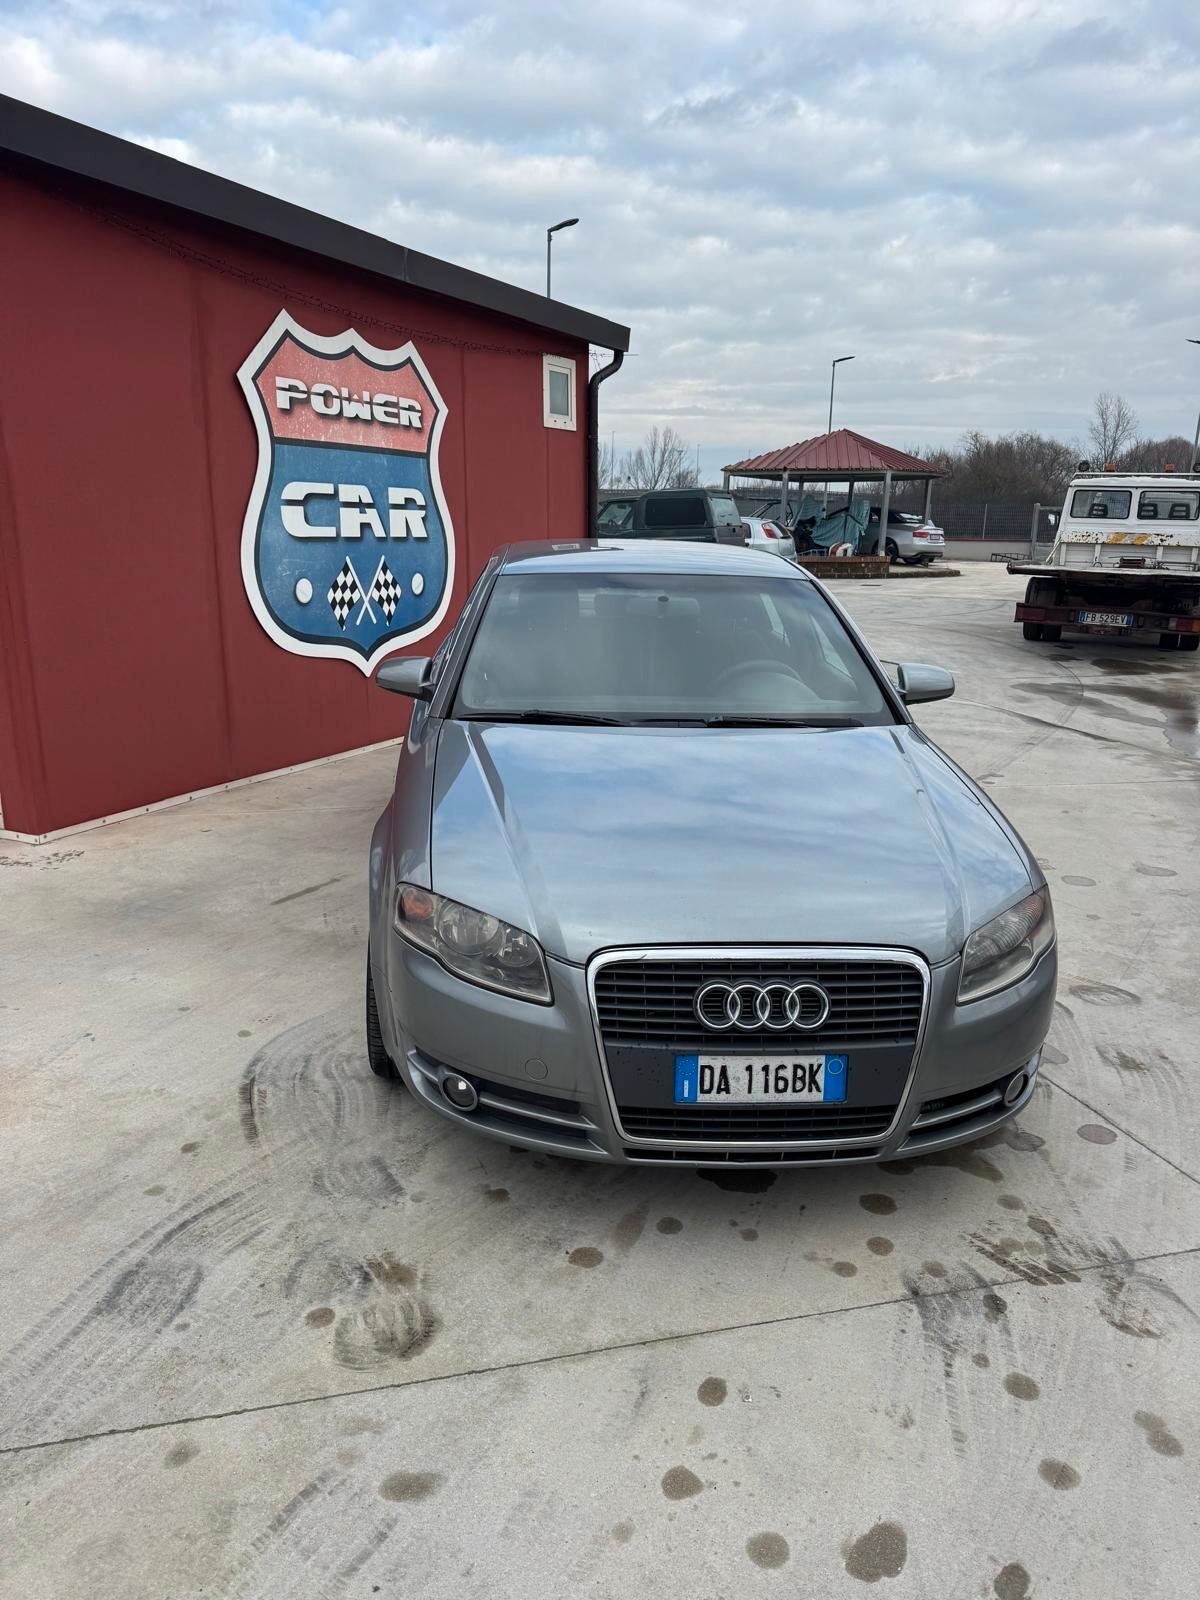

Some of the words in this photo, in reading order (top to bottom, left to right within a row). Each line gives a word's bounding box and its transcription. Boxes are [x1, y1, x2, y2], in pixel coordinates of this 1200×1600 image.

[275, 376, 423, 429] POWER
[280, 481, 428, 538] CAR
[1086, 612, 1097, 622] FB
[699, 1064, 731, 1095] DA
[745, 1063, 823, 1094] 116BK
